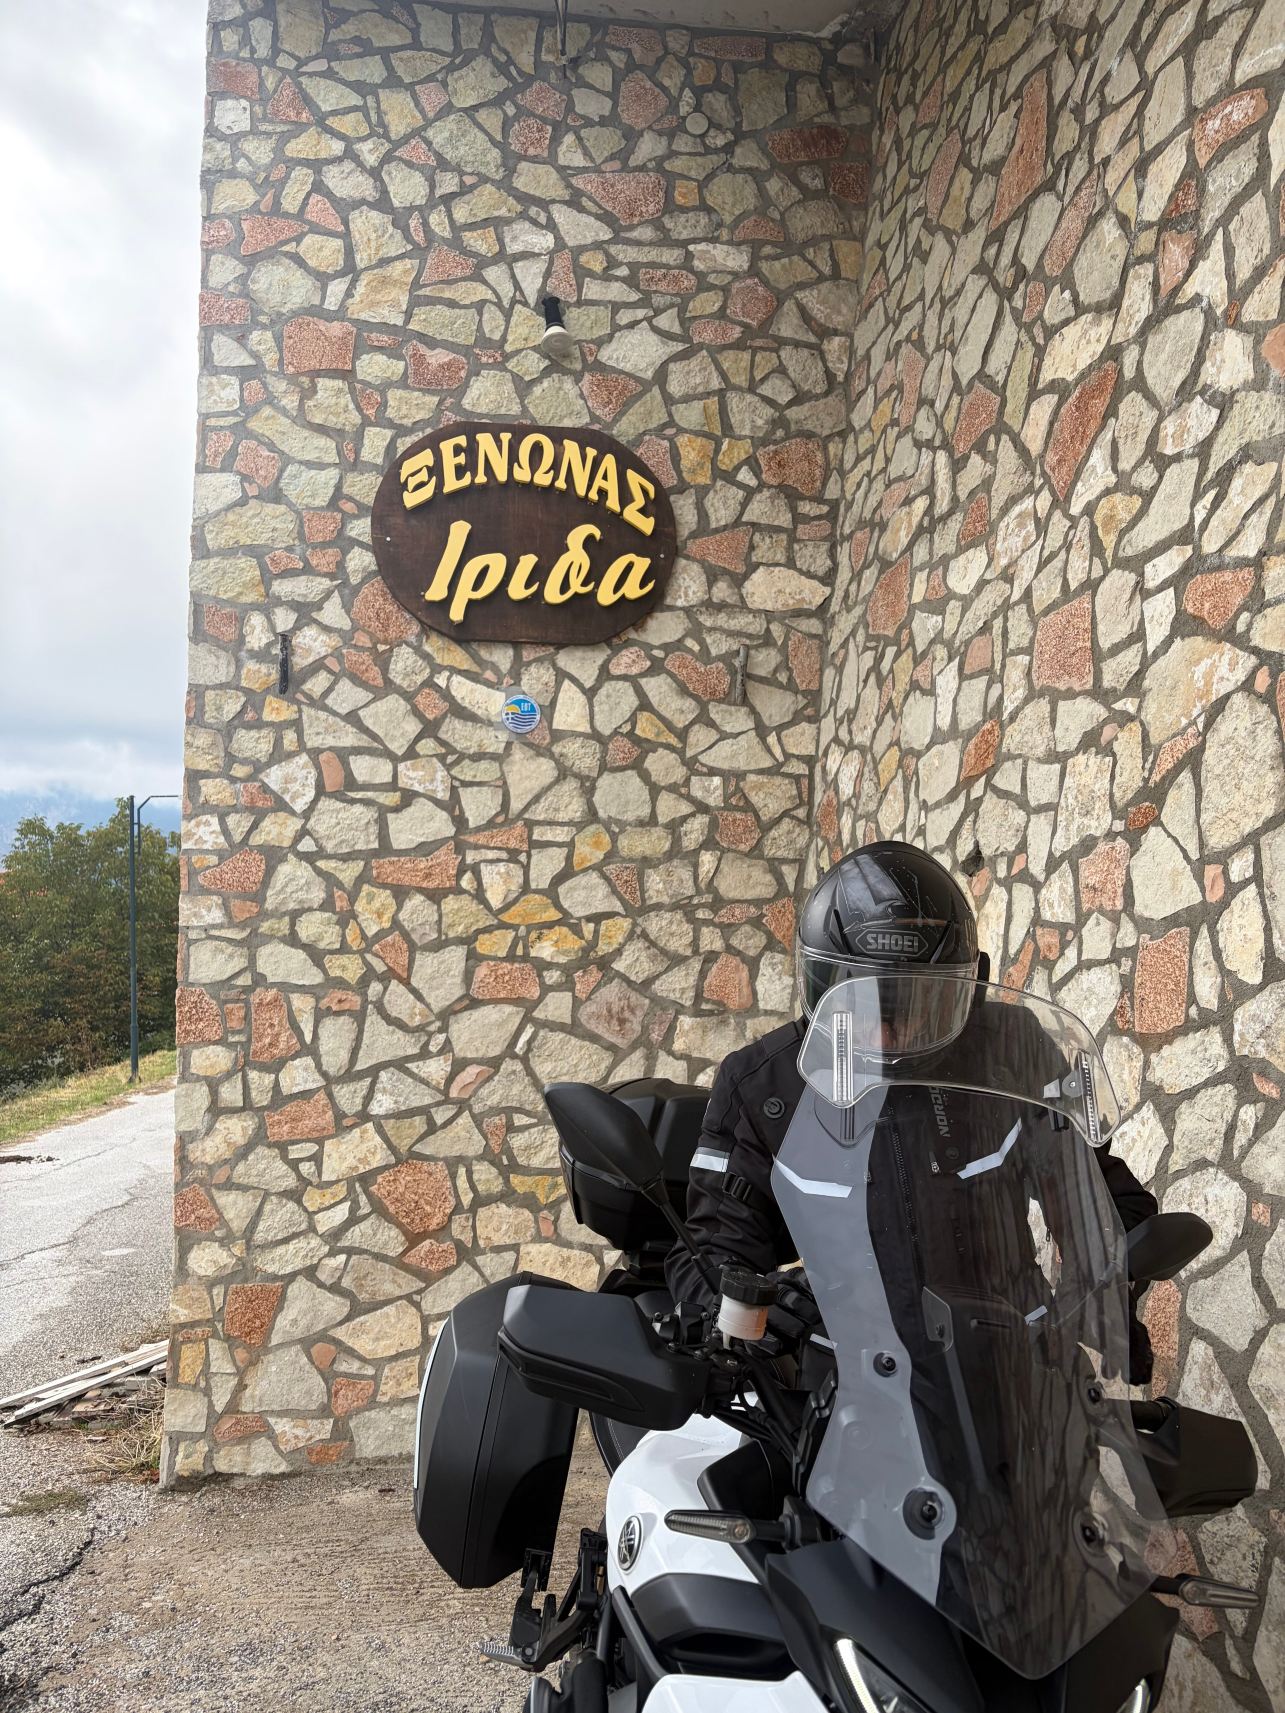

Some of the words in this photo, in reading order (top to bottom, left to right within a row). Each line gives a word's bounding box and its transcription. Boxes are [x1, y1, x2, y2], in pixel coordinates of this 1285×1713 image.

[400, 432, 655, 536] ΞΕΝΩΝΑΣ
[424, 520, 655, 623] Ιριδα
[866, 933, 919, 953] SHOEI
